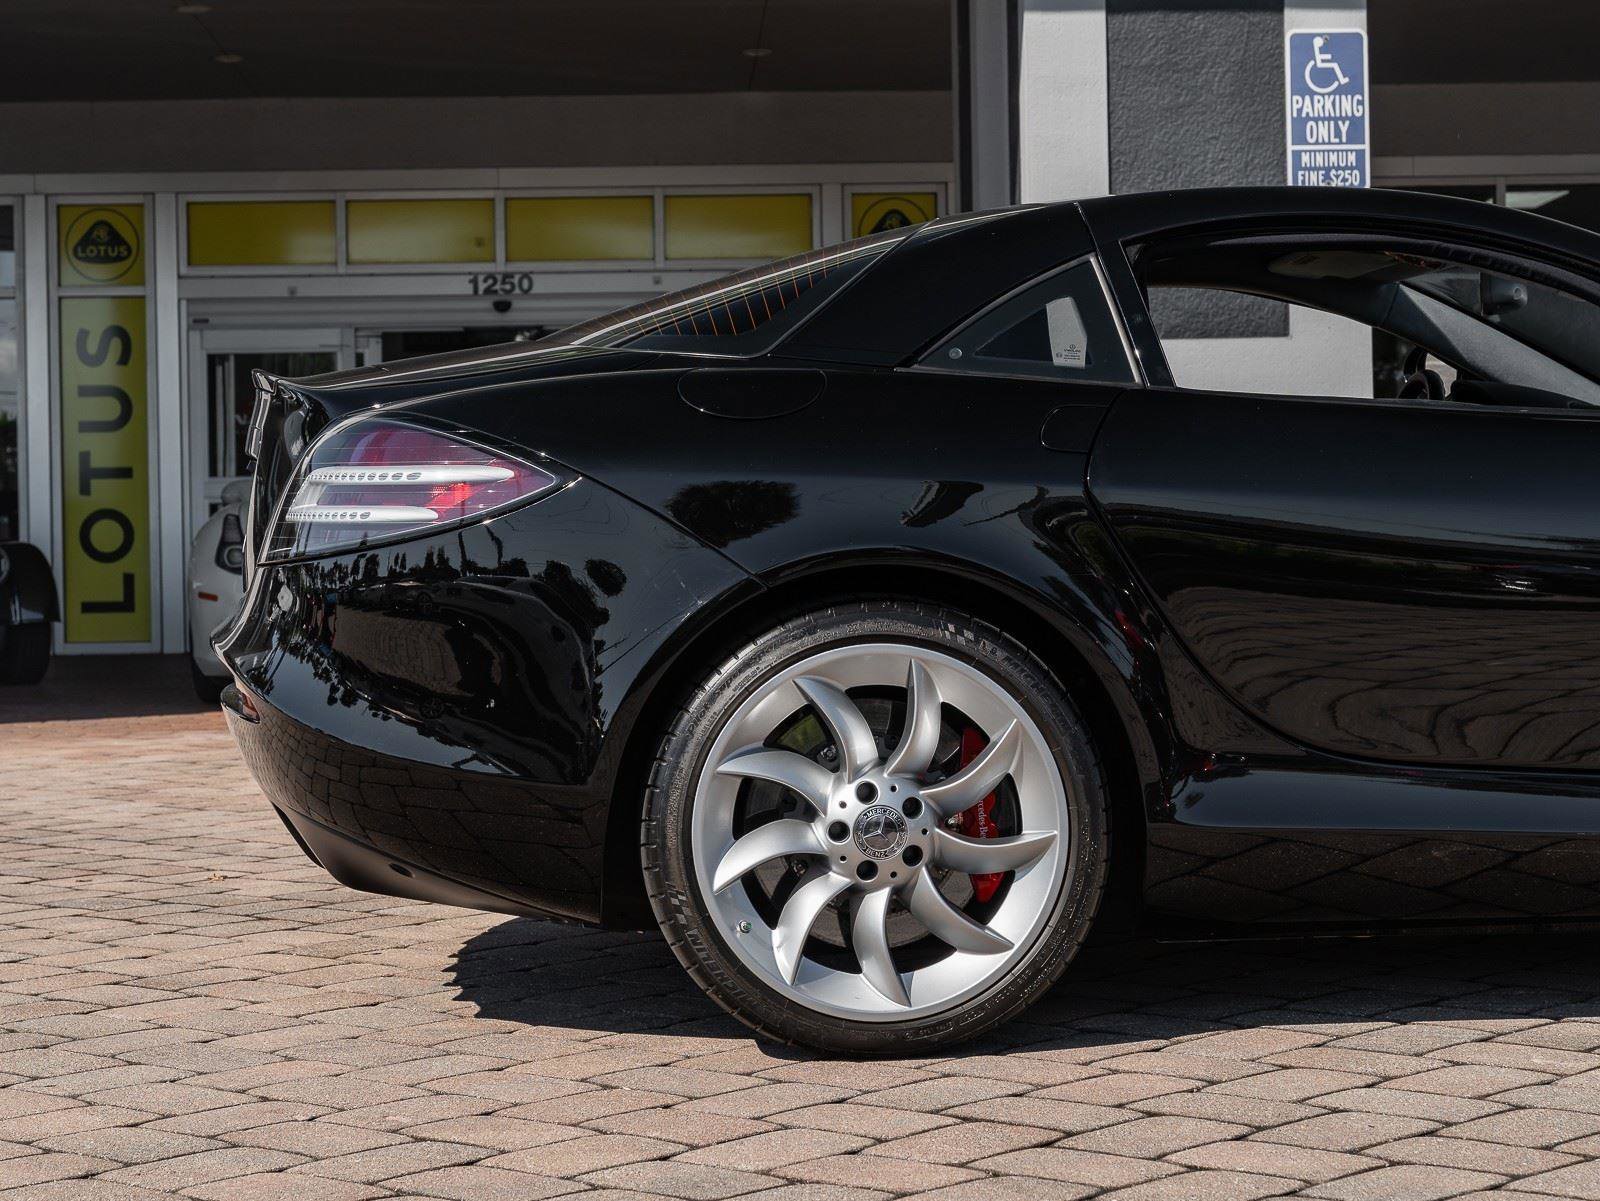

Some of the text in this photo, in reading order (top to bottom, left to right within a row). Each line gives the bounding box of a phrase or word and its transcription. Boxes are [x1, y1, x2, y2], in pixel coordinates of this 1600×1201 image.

[1292, 95, 1363, 117] PARKING
[1306, 121, 1349, 143] ONLY
[1301, 151, 1356, 167] MINIMUM
[1298, 170, 1360, 186] FINE $250
[77, 246, 129, 257] LOTUS
[468, 272, 533, 295] 1250
[76, 324, 135, 614] LOTUS
[865, 846, 887, 857] BENZ
